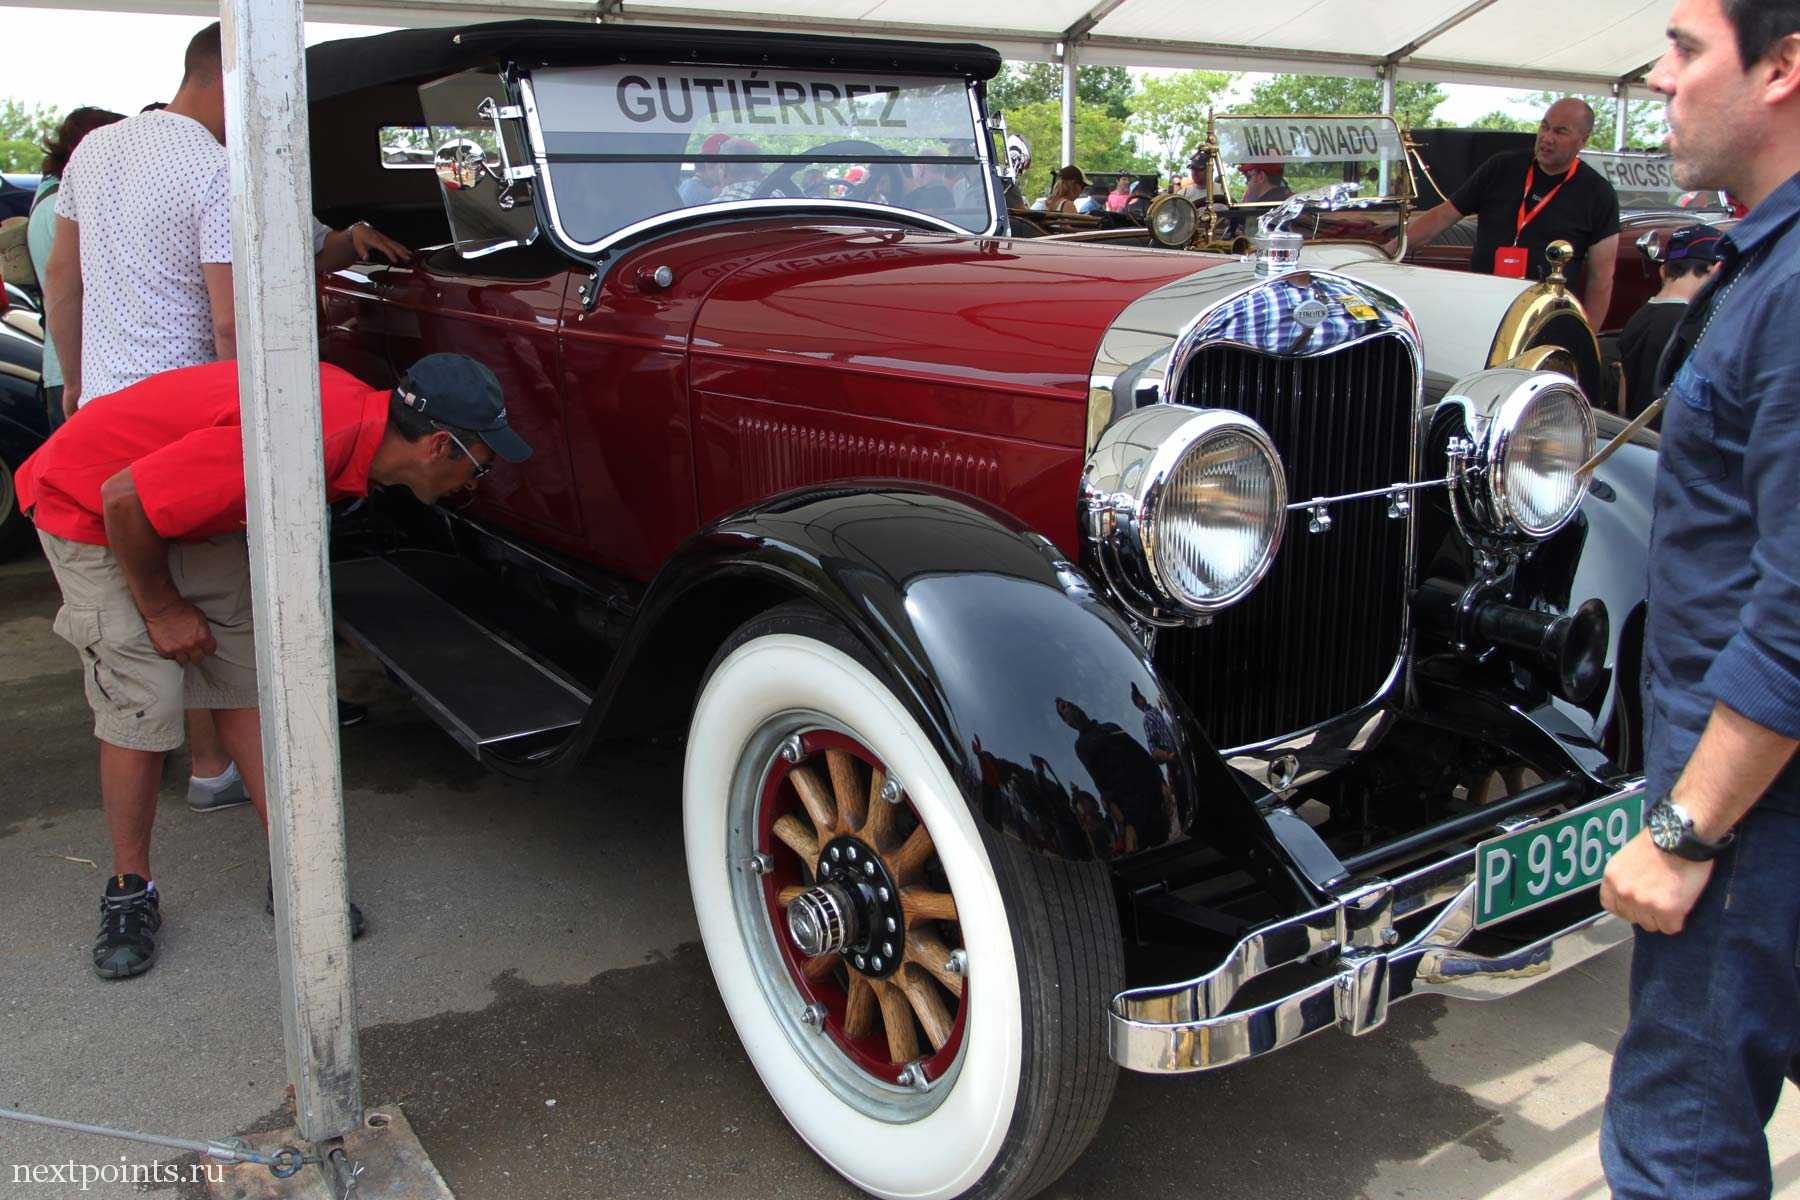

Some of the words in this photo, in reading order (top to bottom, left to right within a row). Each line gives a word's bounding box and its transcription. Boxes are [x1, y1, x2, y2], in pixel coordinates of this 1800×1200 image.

[616, 70, 907, 128] GUTIÉRREZ
[1243, 125, 1378, 156] MALDONADO
[1603, 161, 1676, 187] ERICSS
[1484, 848, 1511, 915] P
